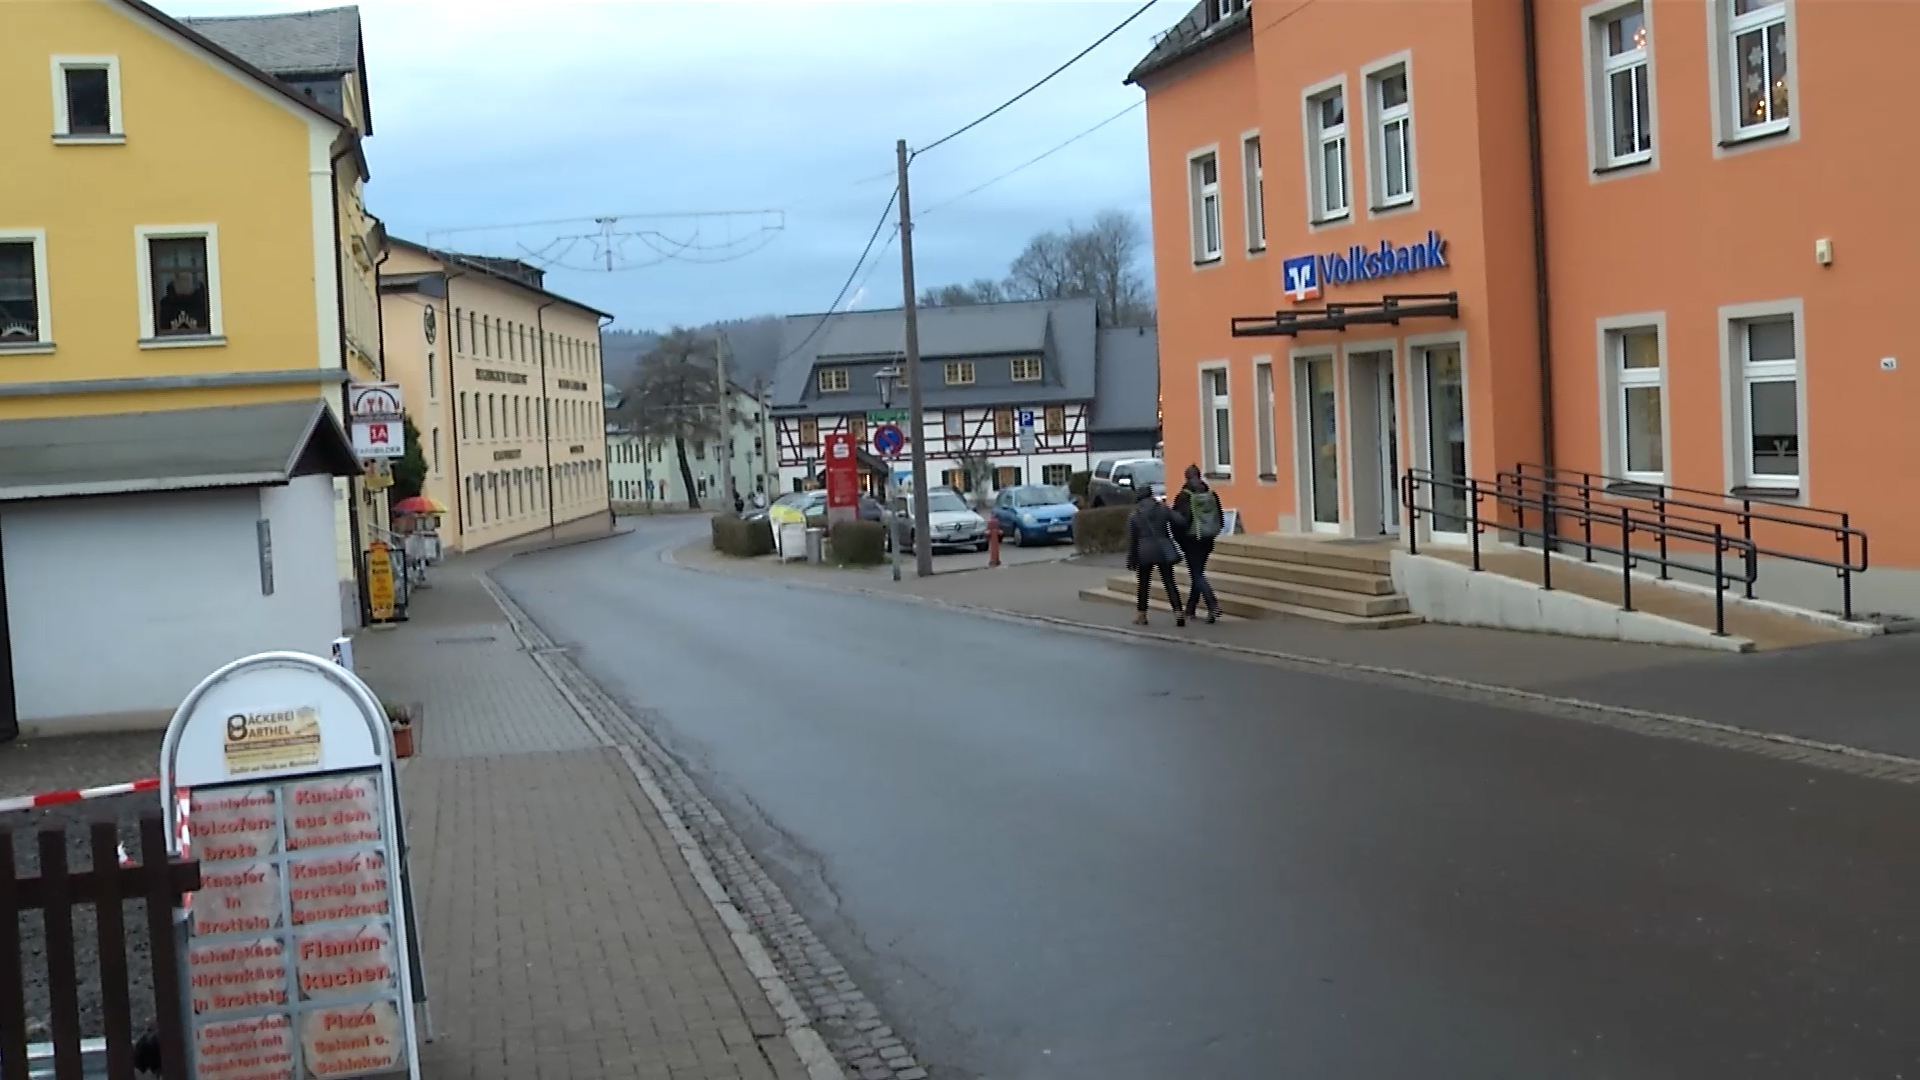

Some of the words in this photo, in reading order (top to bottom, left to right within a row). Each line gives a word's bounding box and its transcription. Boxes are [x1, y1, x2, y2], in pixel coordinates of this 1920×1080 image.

[1320, 230, 1447, 285] Volksbank
[1021, 412, 1031, 424] P
[371, 427, 387, 440] 1A
[295, 786, 365, 806] Kuchen
[294, 815, 327, 829] aus
[332, 810, 372, 826] dem
[360, 879, 387, 894] mit
[301, 937, 388, 959] Flamm-
[313, 1034, 370, 1054] Salami
[315, 1055, 392, 1074] Schinken
